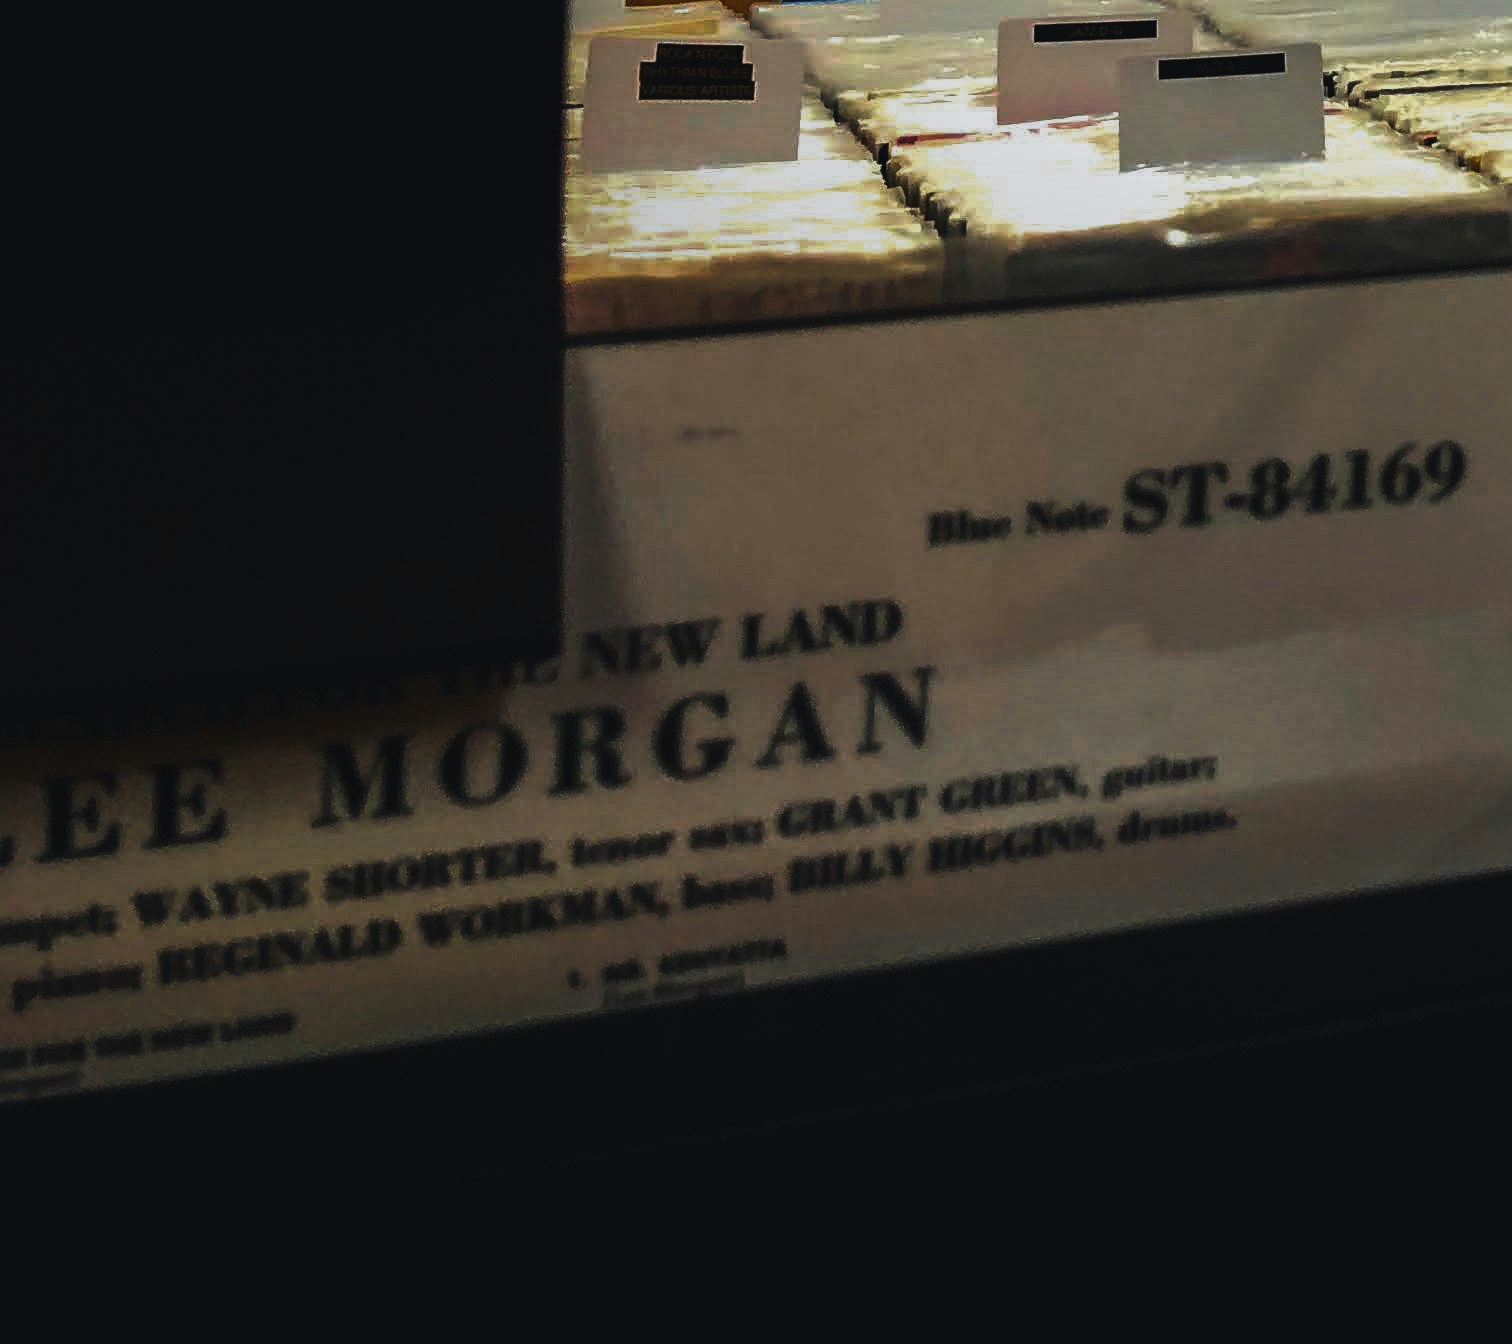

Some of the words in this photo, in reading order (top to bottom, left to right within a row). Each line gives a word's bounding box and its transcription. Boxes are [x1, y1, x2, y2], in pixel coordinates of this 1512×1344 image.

[1069, 25, 1098, 37] JAZZ
[927, 508, 1012, 548] Blue
[1026, 499, 1110, 538] Note
[1121, 440, 1469, 538] ST-84169
[580, 616, 724, 682] NEW
[741, 598, 905, 664] LAND
[0, 758, 229, 869] EE
[310, 664, 934, 831] MORGAN
[131, 868, 310, 928] WAYNE
[323, 838, 557, 903] SHORTER,
[774, 783, 928, 838] GRANT
[939, 766, 1089, 814] GREEN,
[154, 918, 403, 985] REGINALD
[416, 881, 672, 948] WORKMAN,
[787, 841, 914, 894] BILLY
[927, 814, 1104, 873] HIGGINS,
